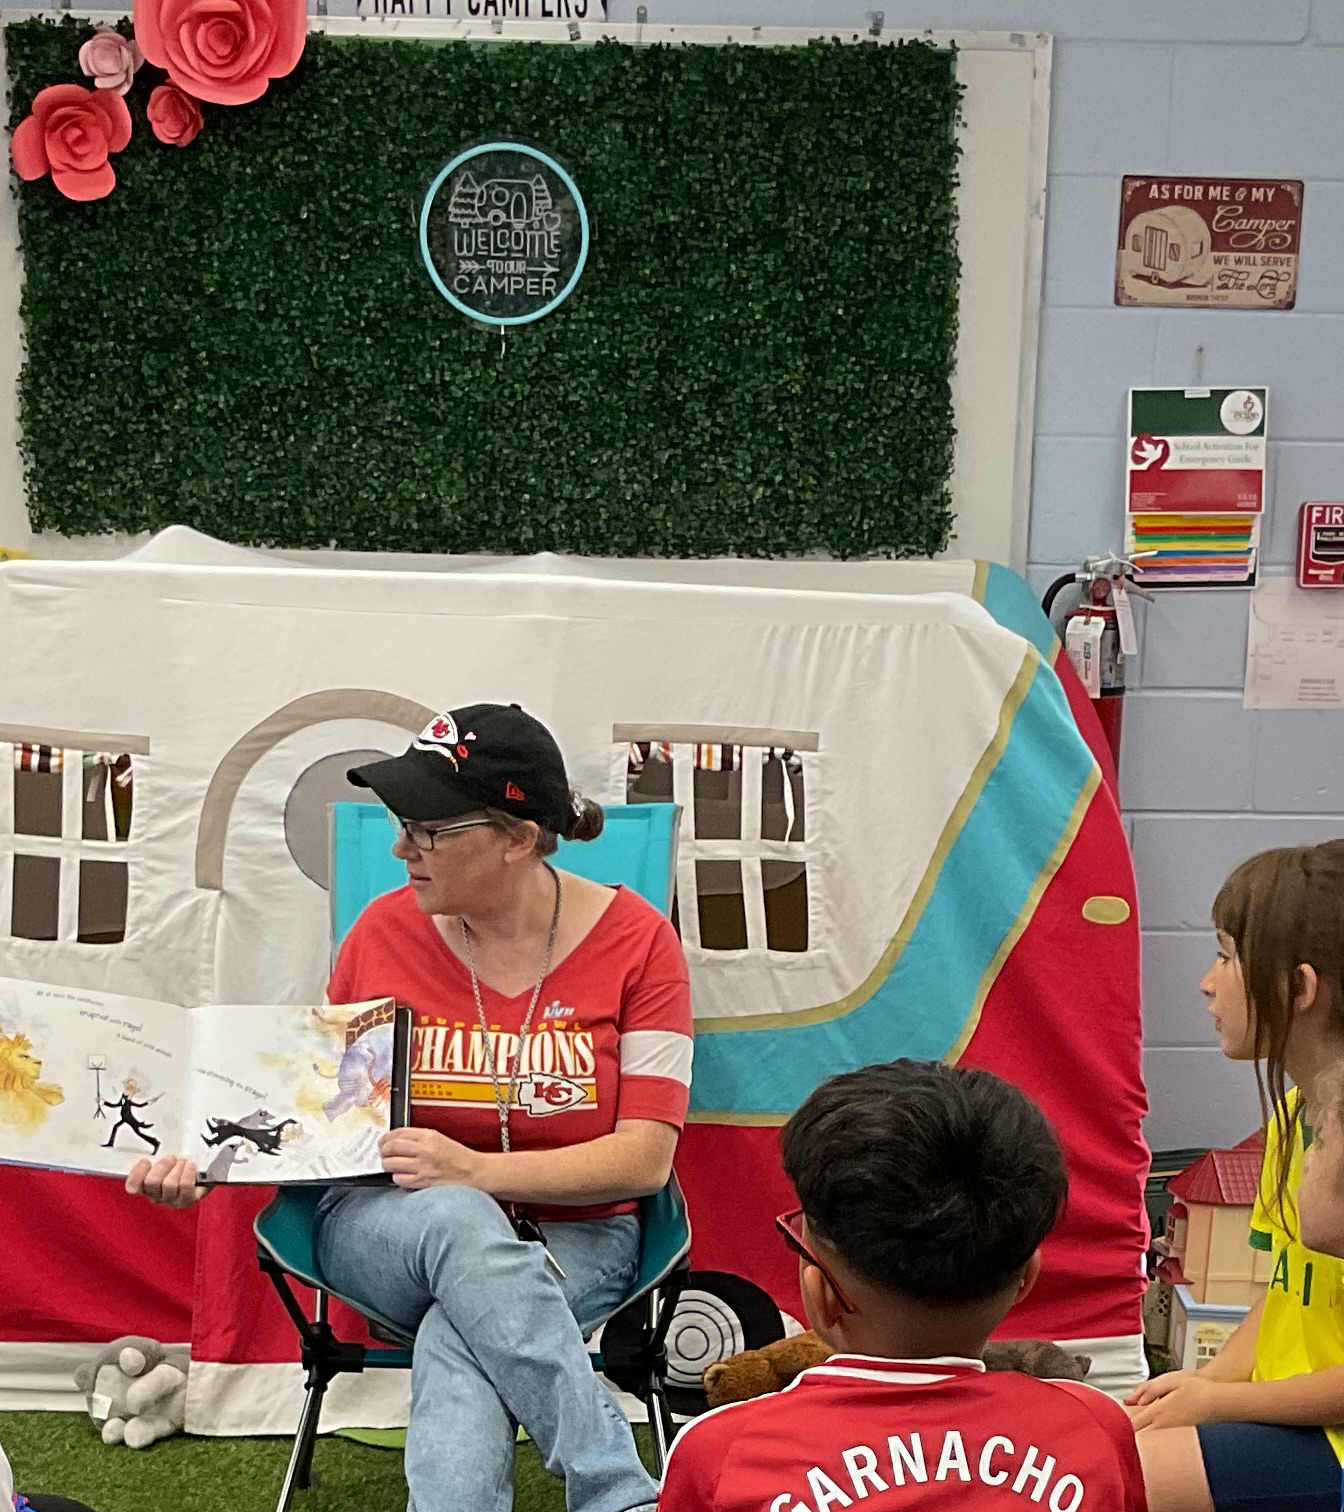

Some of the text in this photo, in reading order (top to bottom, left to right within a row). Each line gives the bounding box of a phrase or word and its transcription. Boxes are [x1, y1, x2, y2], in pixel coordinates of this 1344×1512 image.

[1149, 185, 1170, 199] AS
[1174, 186, 1203, 200] FOR
[1208, 186, 1230, 200] ME
[1251, 188, 1275, 202] MY
[1212, 205, 1296, 250] Camper
[454, 229, 561, 257] WELCOME
[1213, 255, 1292, 266] WE WILL SERVE
[454, 275, 556, 296] CAMPER
[411, 1026, 596, 1077] CHAMPIONS
